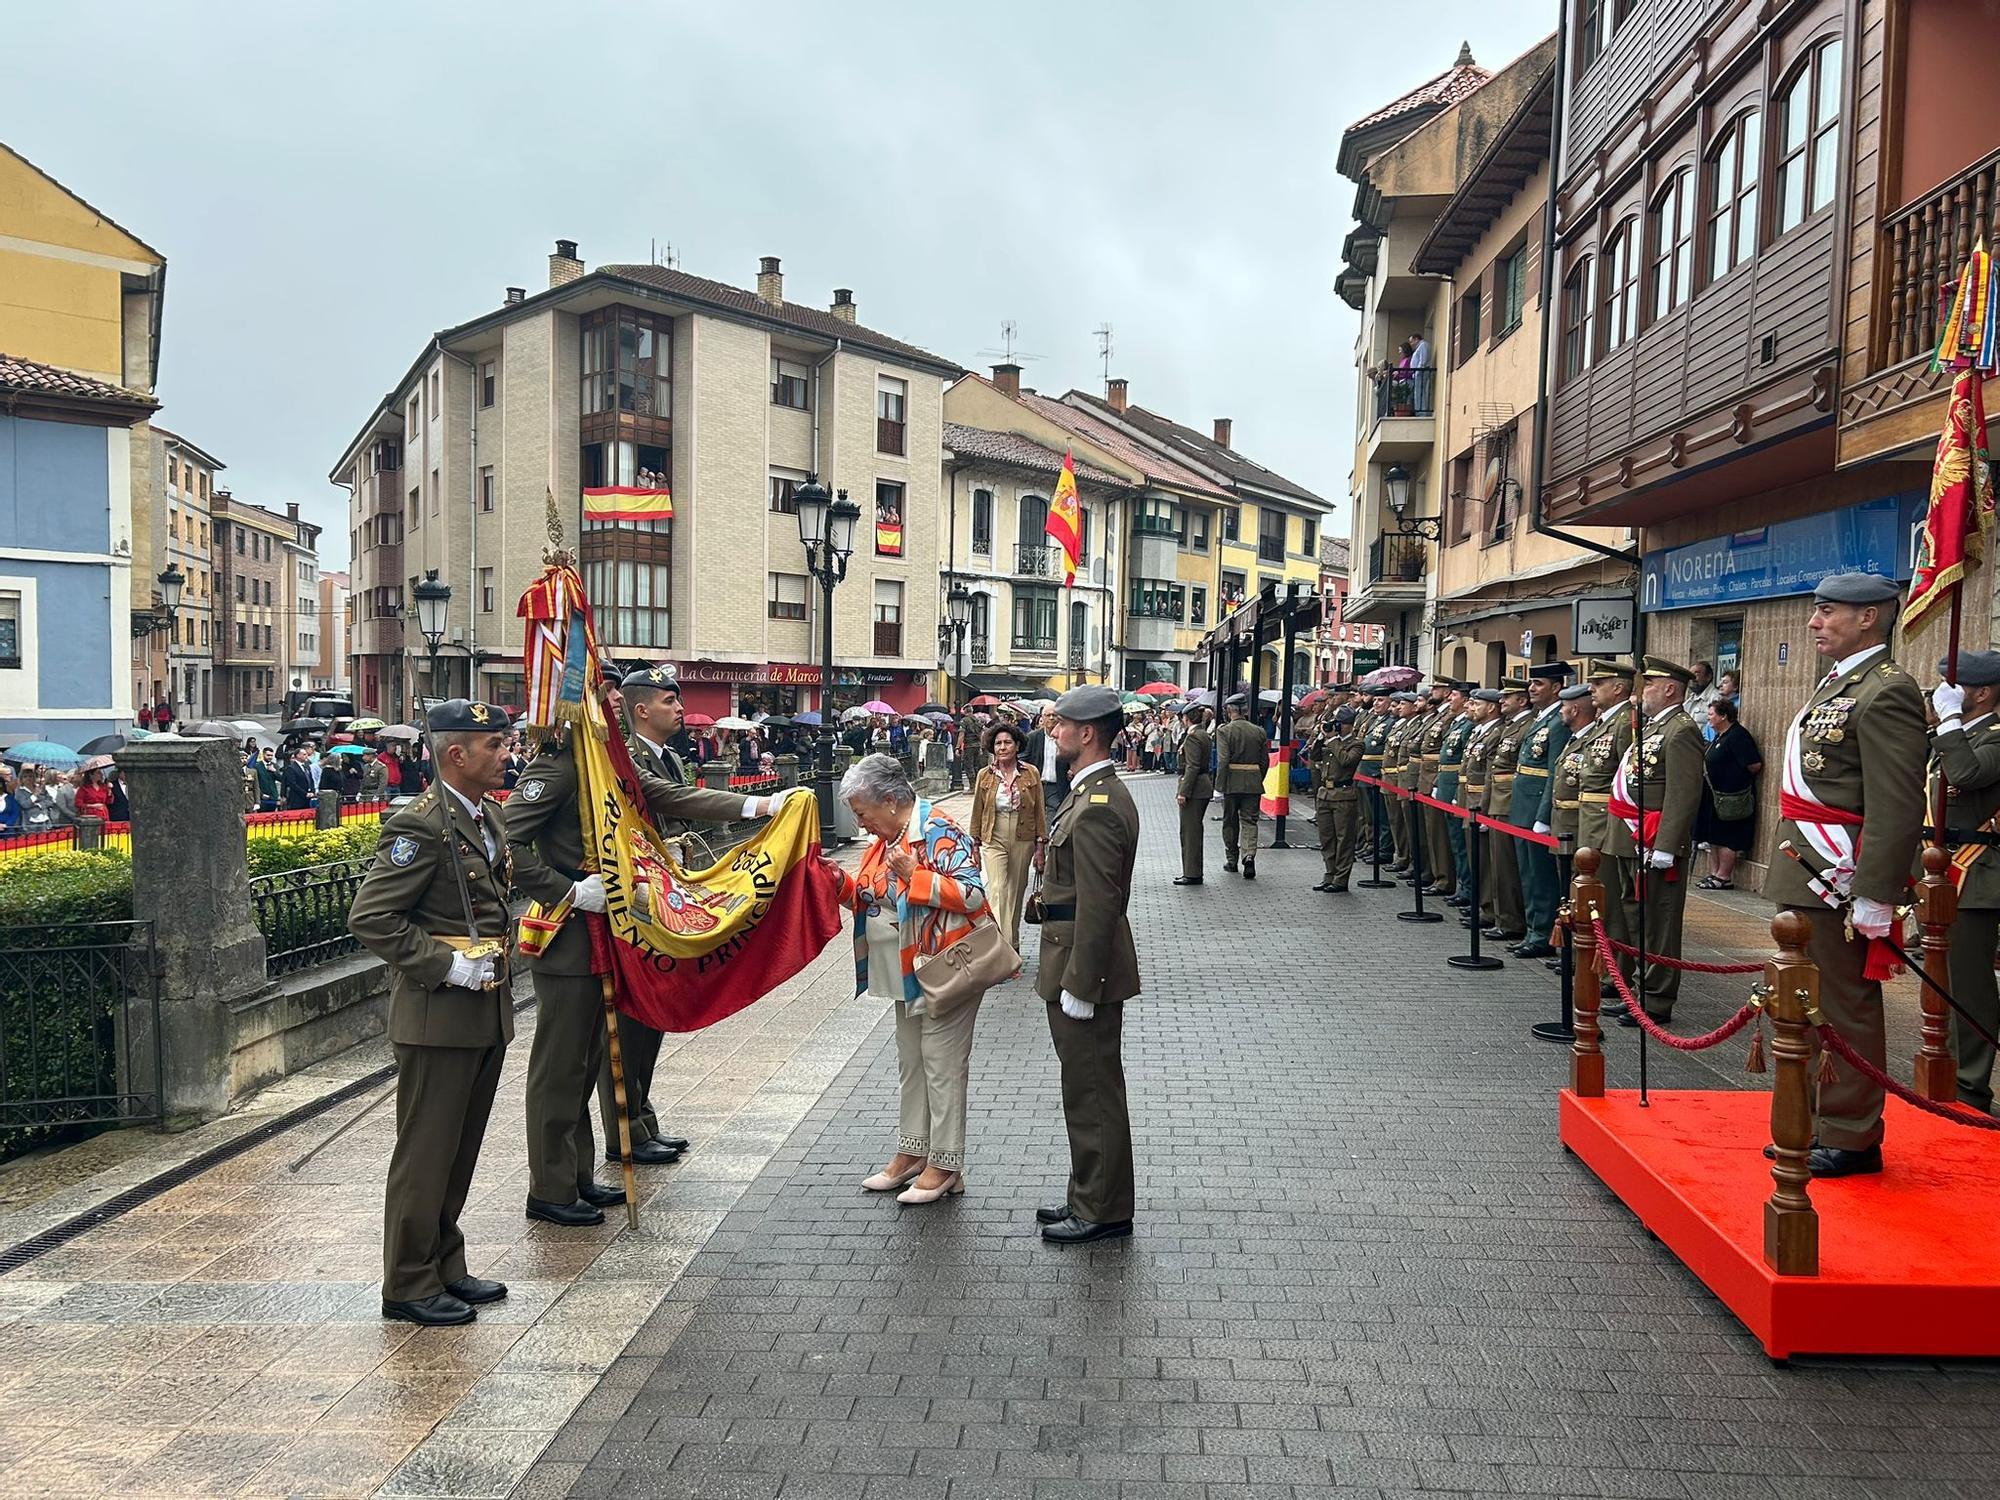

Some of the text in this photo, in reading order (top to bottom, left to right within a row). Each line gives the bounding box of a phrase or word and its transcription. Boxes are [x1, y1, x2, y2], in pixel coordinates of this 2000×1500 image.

[1776, 572, 1797, 585] Locales
[1582, 619, 1628, 635] HATCHET
[680, 665, 696, 680] La
[700, 666, 767, 682] Carnicería
[770, 667, 782, 681] de
[785, 667, 819, 683] Marco
